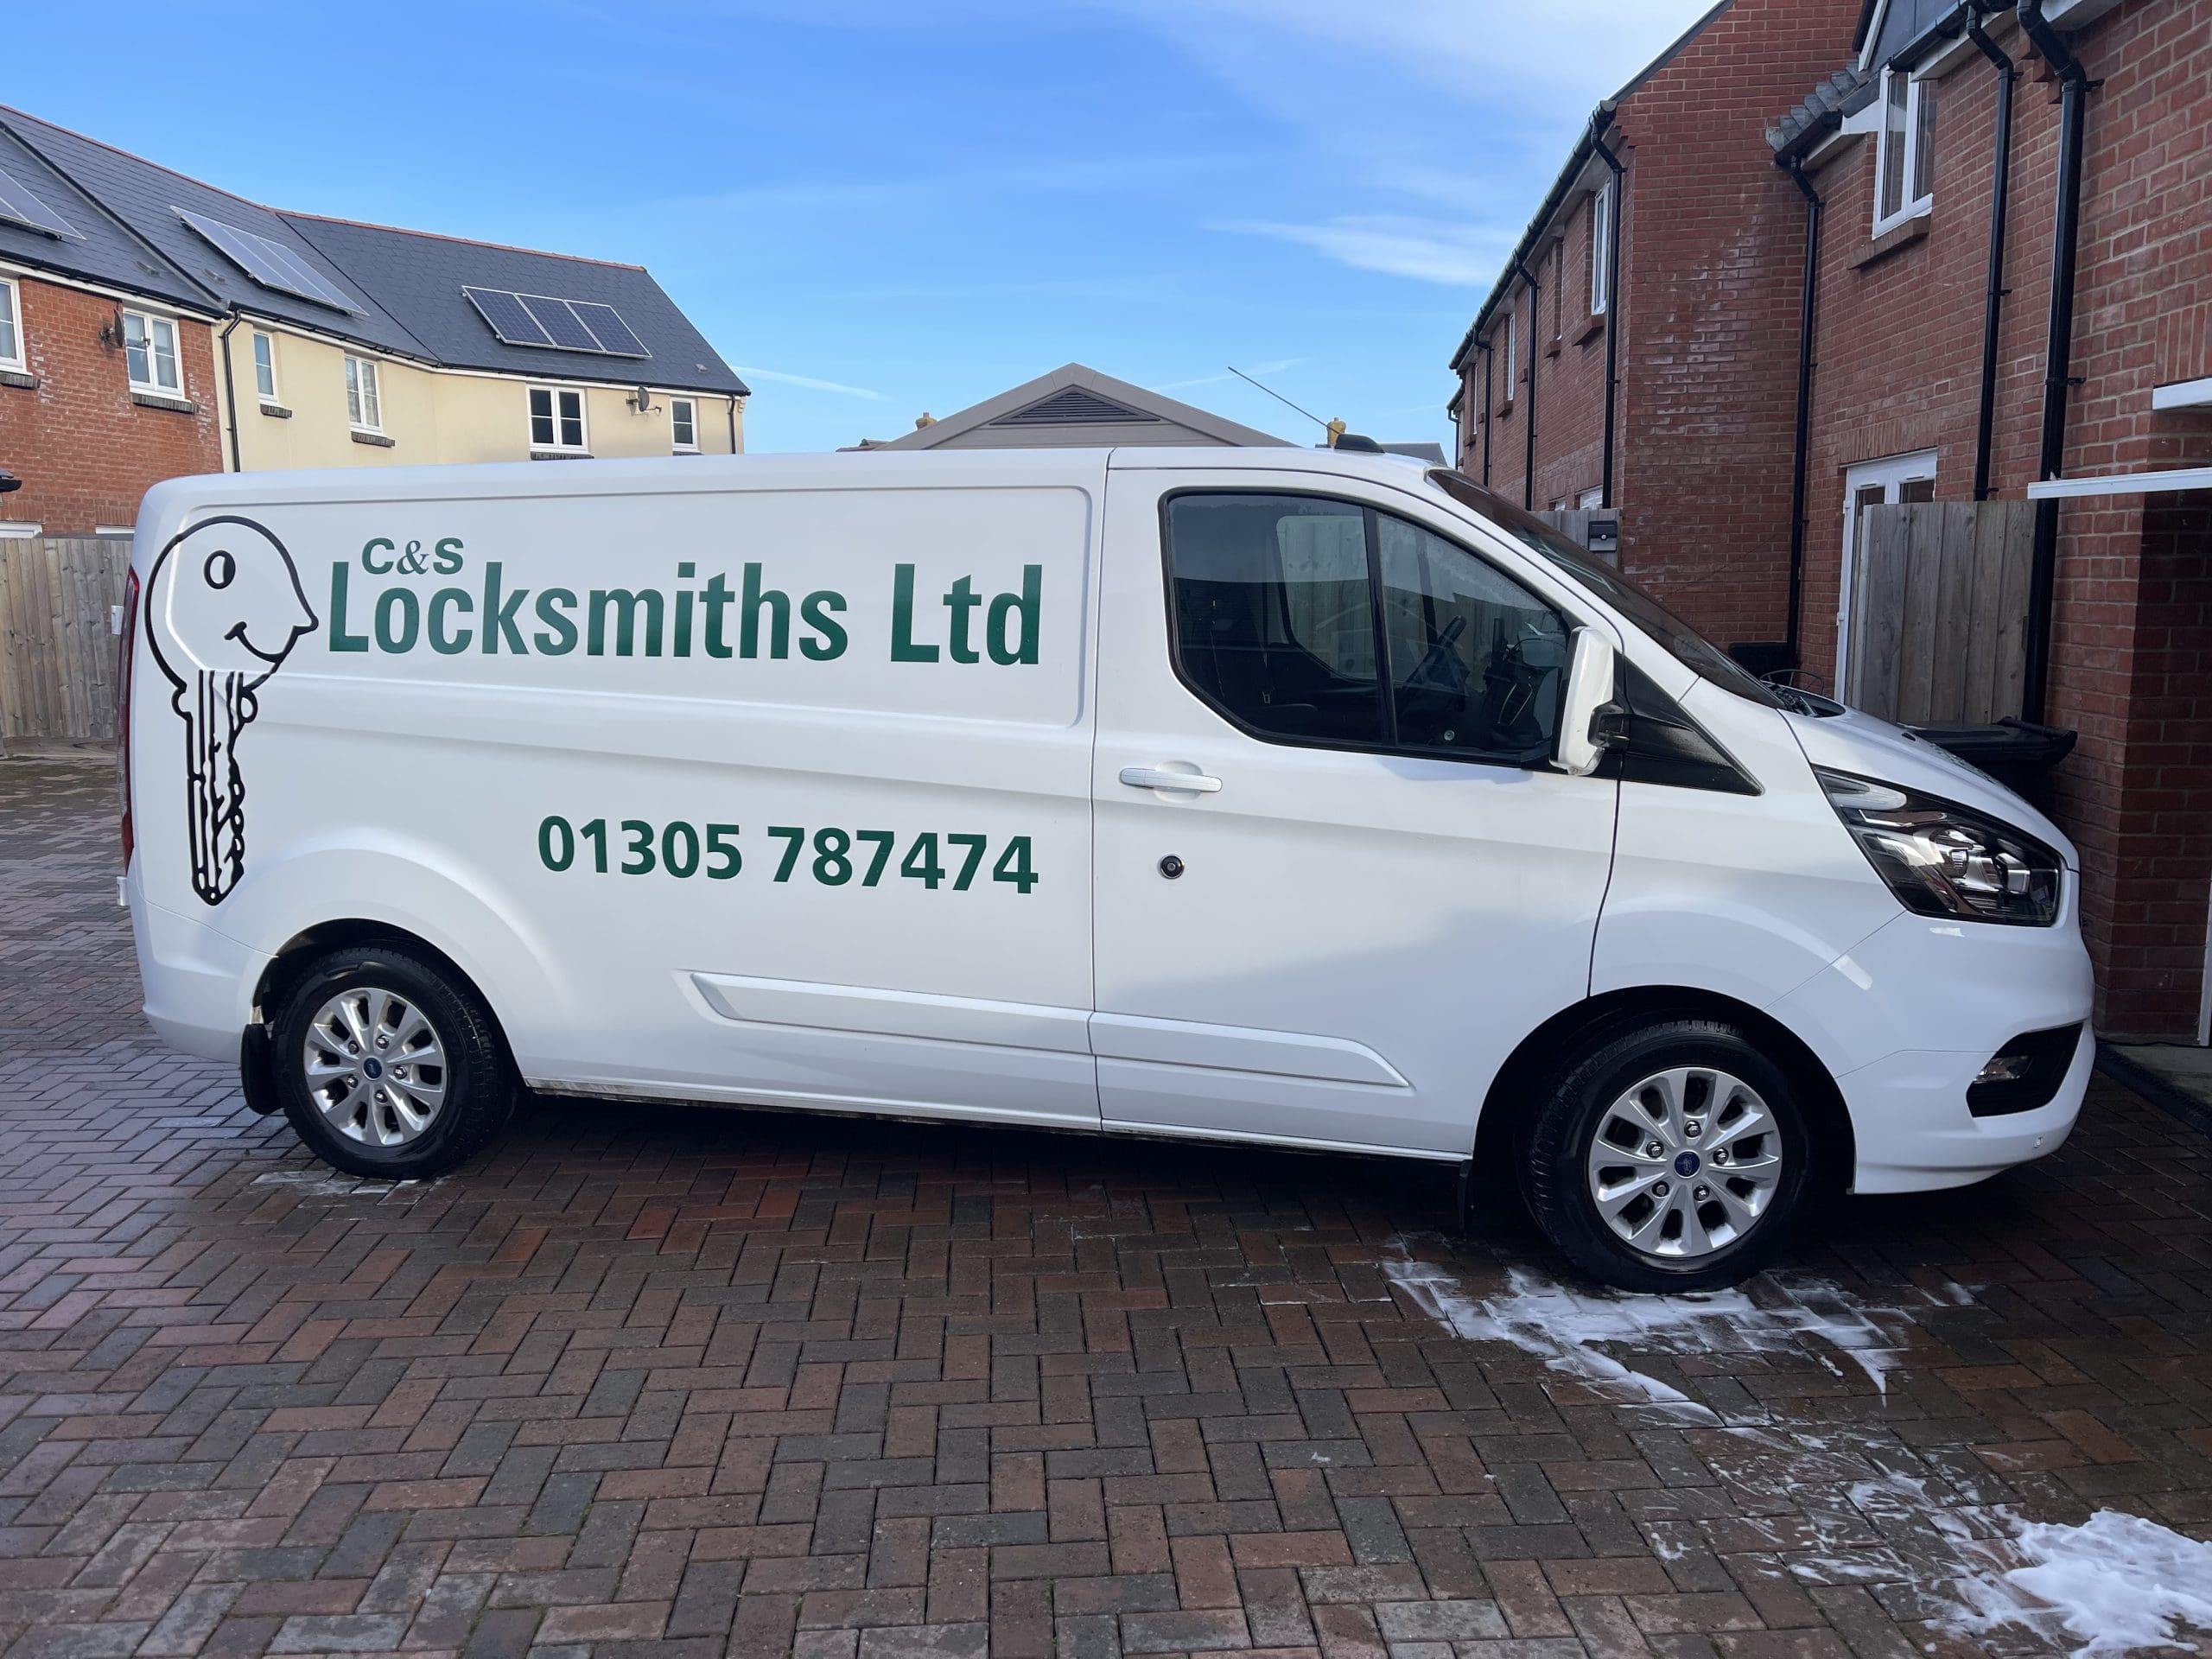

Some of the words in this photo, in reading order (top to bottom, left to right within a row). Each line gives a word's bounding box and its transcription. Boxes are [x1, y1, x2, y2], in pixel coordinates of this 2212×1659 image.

[363, 537, 464, 575] C&S
[330, 563, 848, 661] Locksmiths
[890, 564, 1041, 664] Ltd
[538, 815, 742, 880] 01305
[767, 825, 1039, 894] 787474
